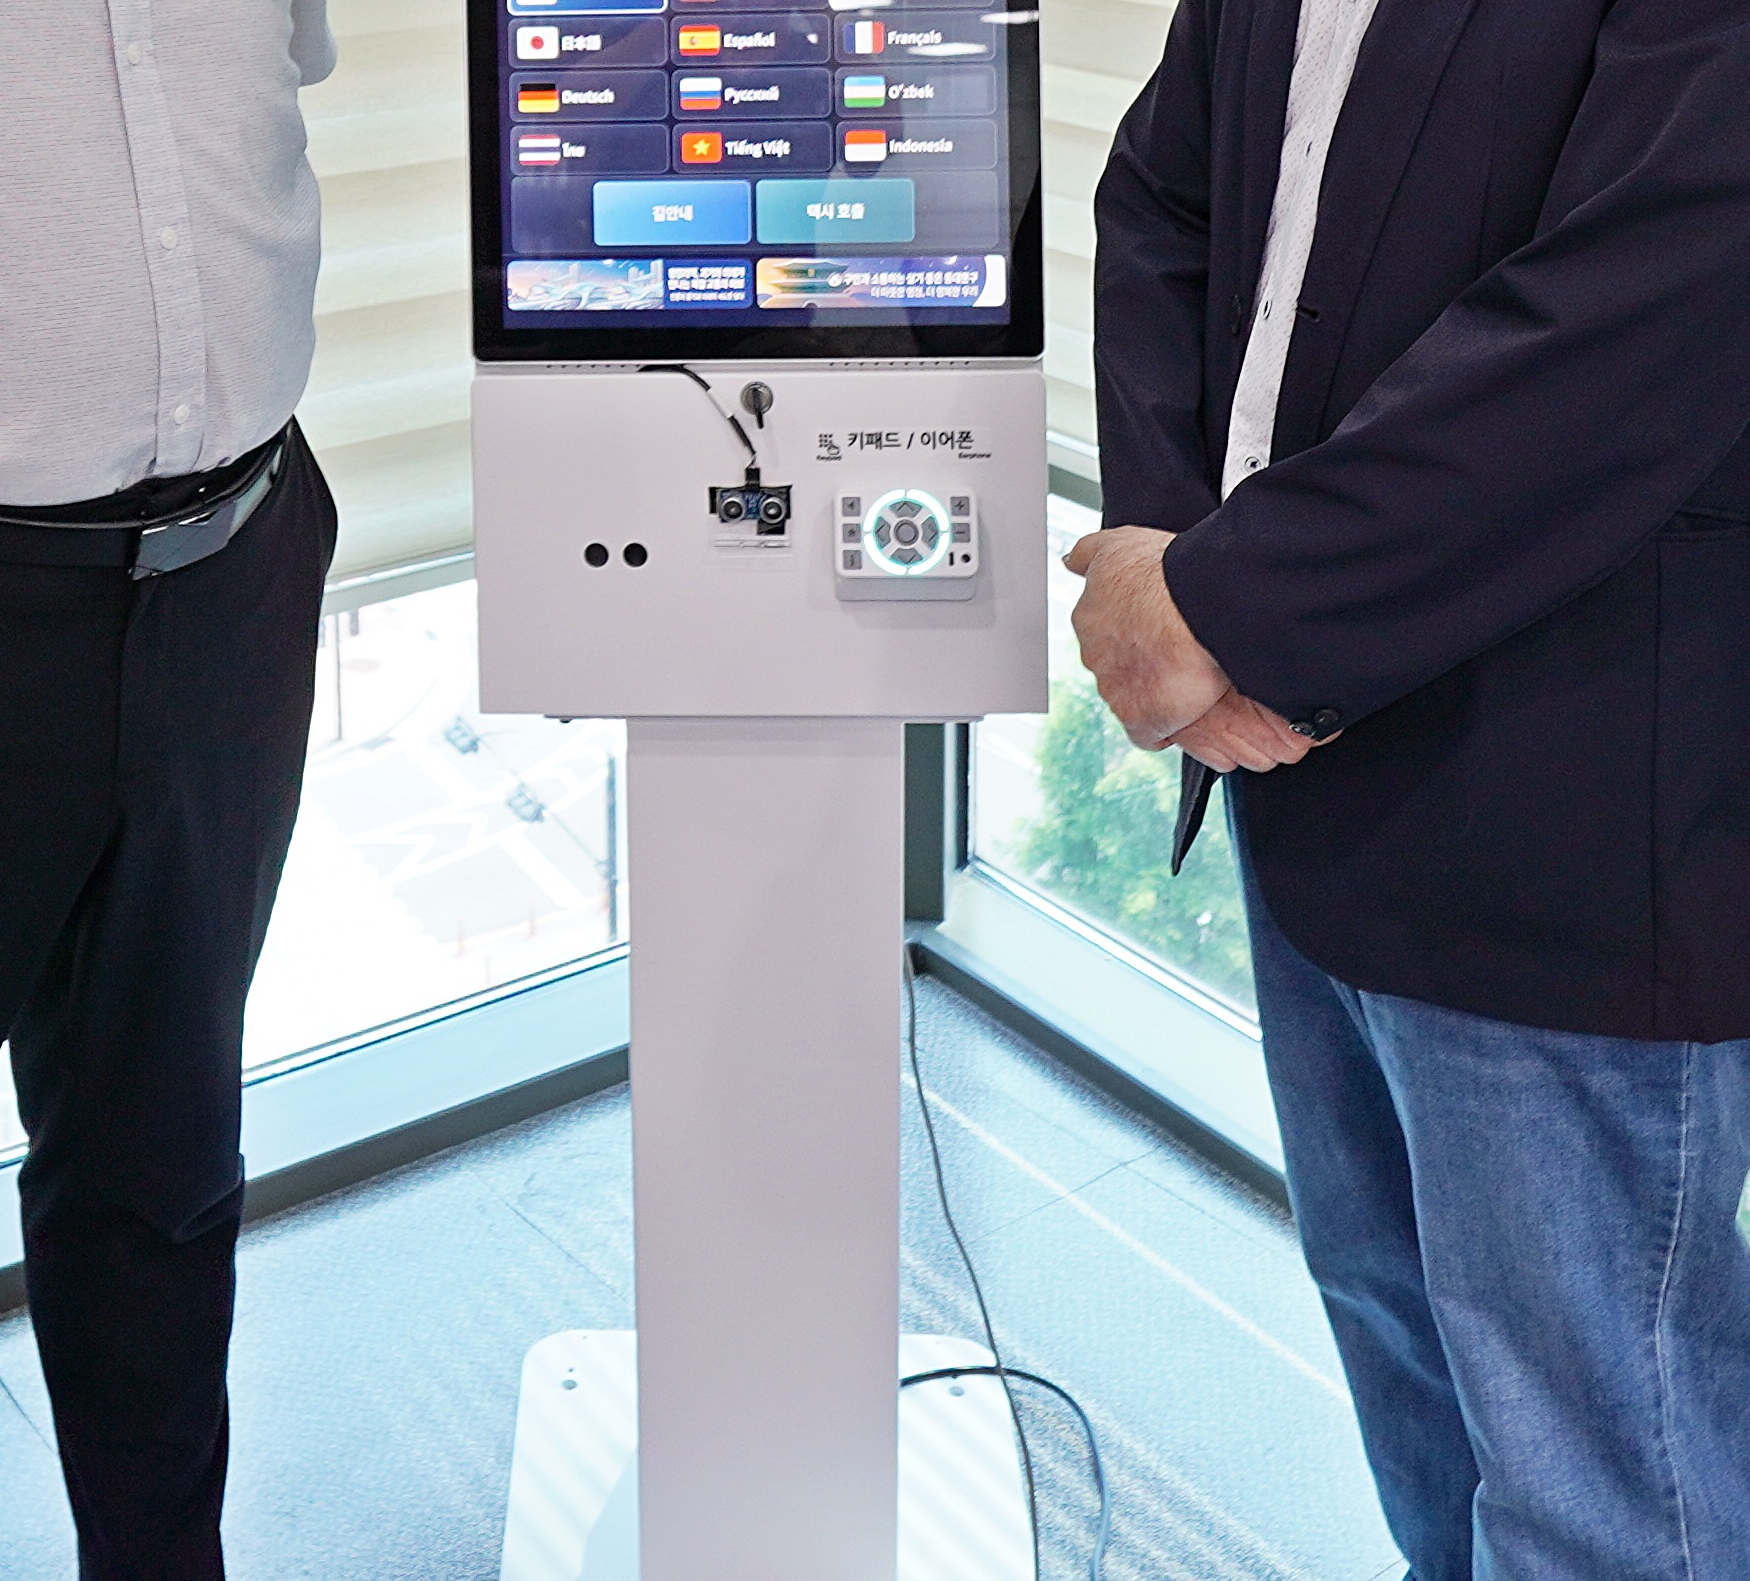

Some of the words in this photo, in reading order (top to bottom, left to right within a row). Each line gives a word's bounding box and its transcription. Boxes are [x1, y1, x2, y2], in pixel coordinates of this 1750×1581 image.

[723, 32, 776, 50] Español
[887, 29, 942, 47] Français
[561, 89, 615, 104] Deutsch
[724, 86, 780, 104] Русский
[889, 138, 953, 153] Indonesia
[652, 204, 693, 222] 길안내
[806, 203, 834, 220] 택시
[848, 431, 902, 451] 키패드
[906, 432, 915, 450] /
[920, 430, 975, 450] 이어폰
